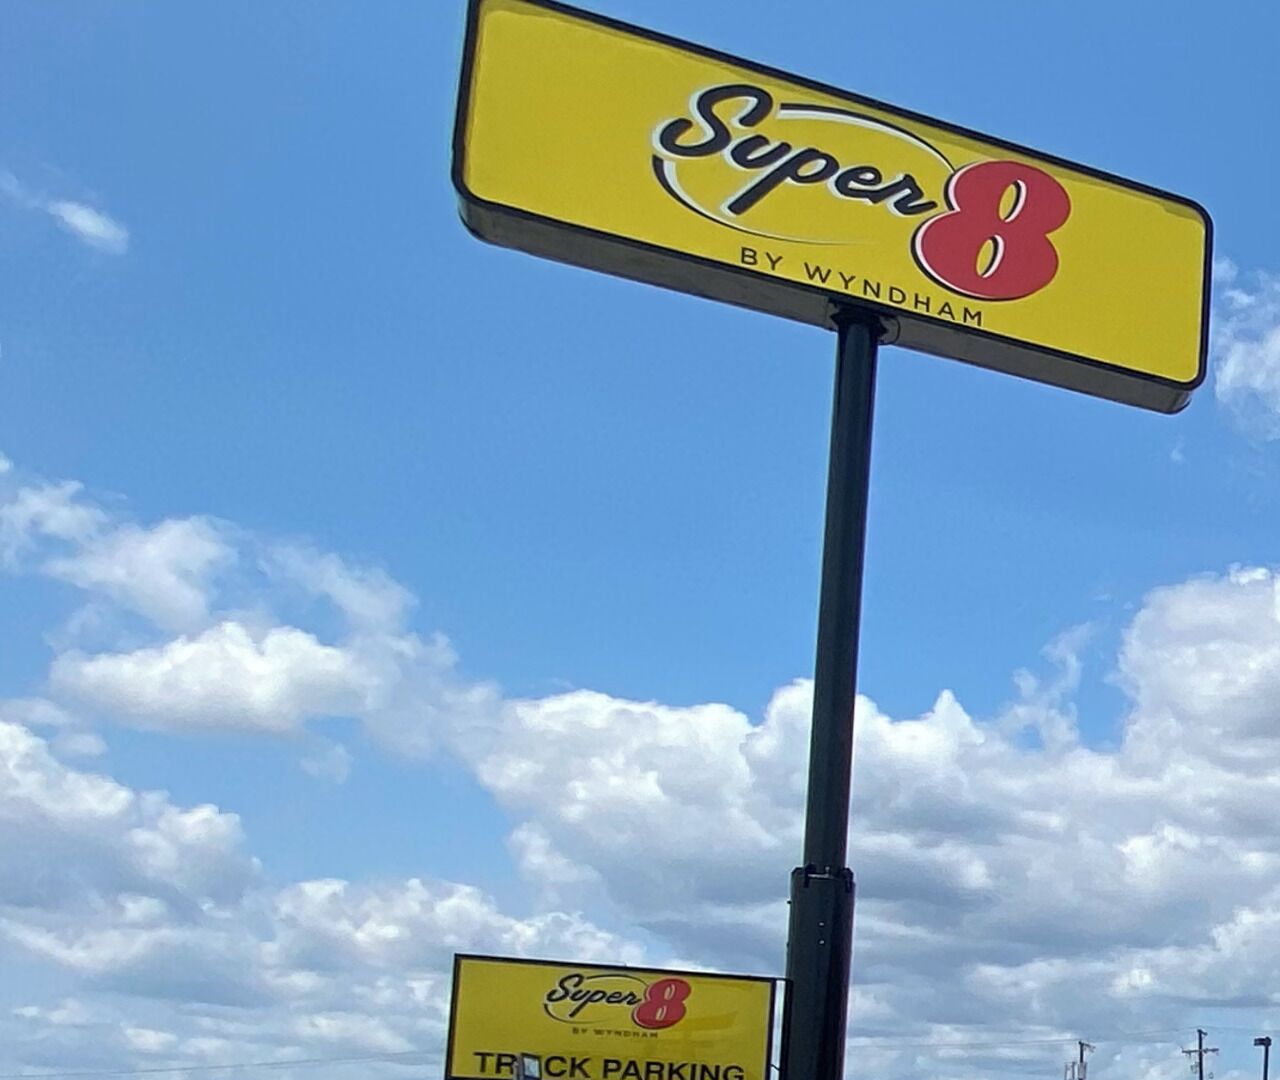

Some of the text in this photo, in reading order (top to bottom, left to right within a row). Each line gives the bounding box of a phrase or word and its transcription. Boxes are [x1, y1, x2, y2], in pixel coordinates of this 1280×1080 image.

[656, 83, 1072, 302] Super 8
[740, 246, 984, 328] BY WYNDHAM
[546, 973, 692, 1030] Super 8
[572, 1027, 659, 1038] BY WYNDHAM
[473, 1051, 591, 1079] TRCK
